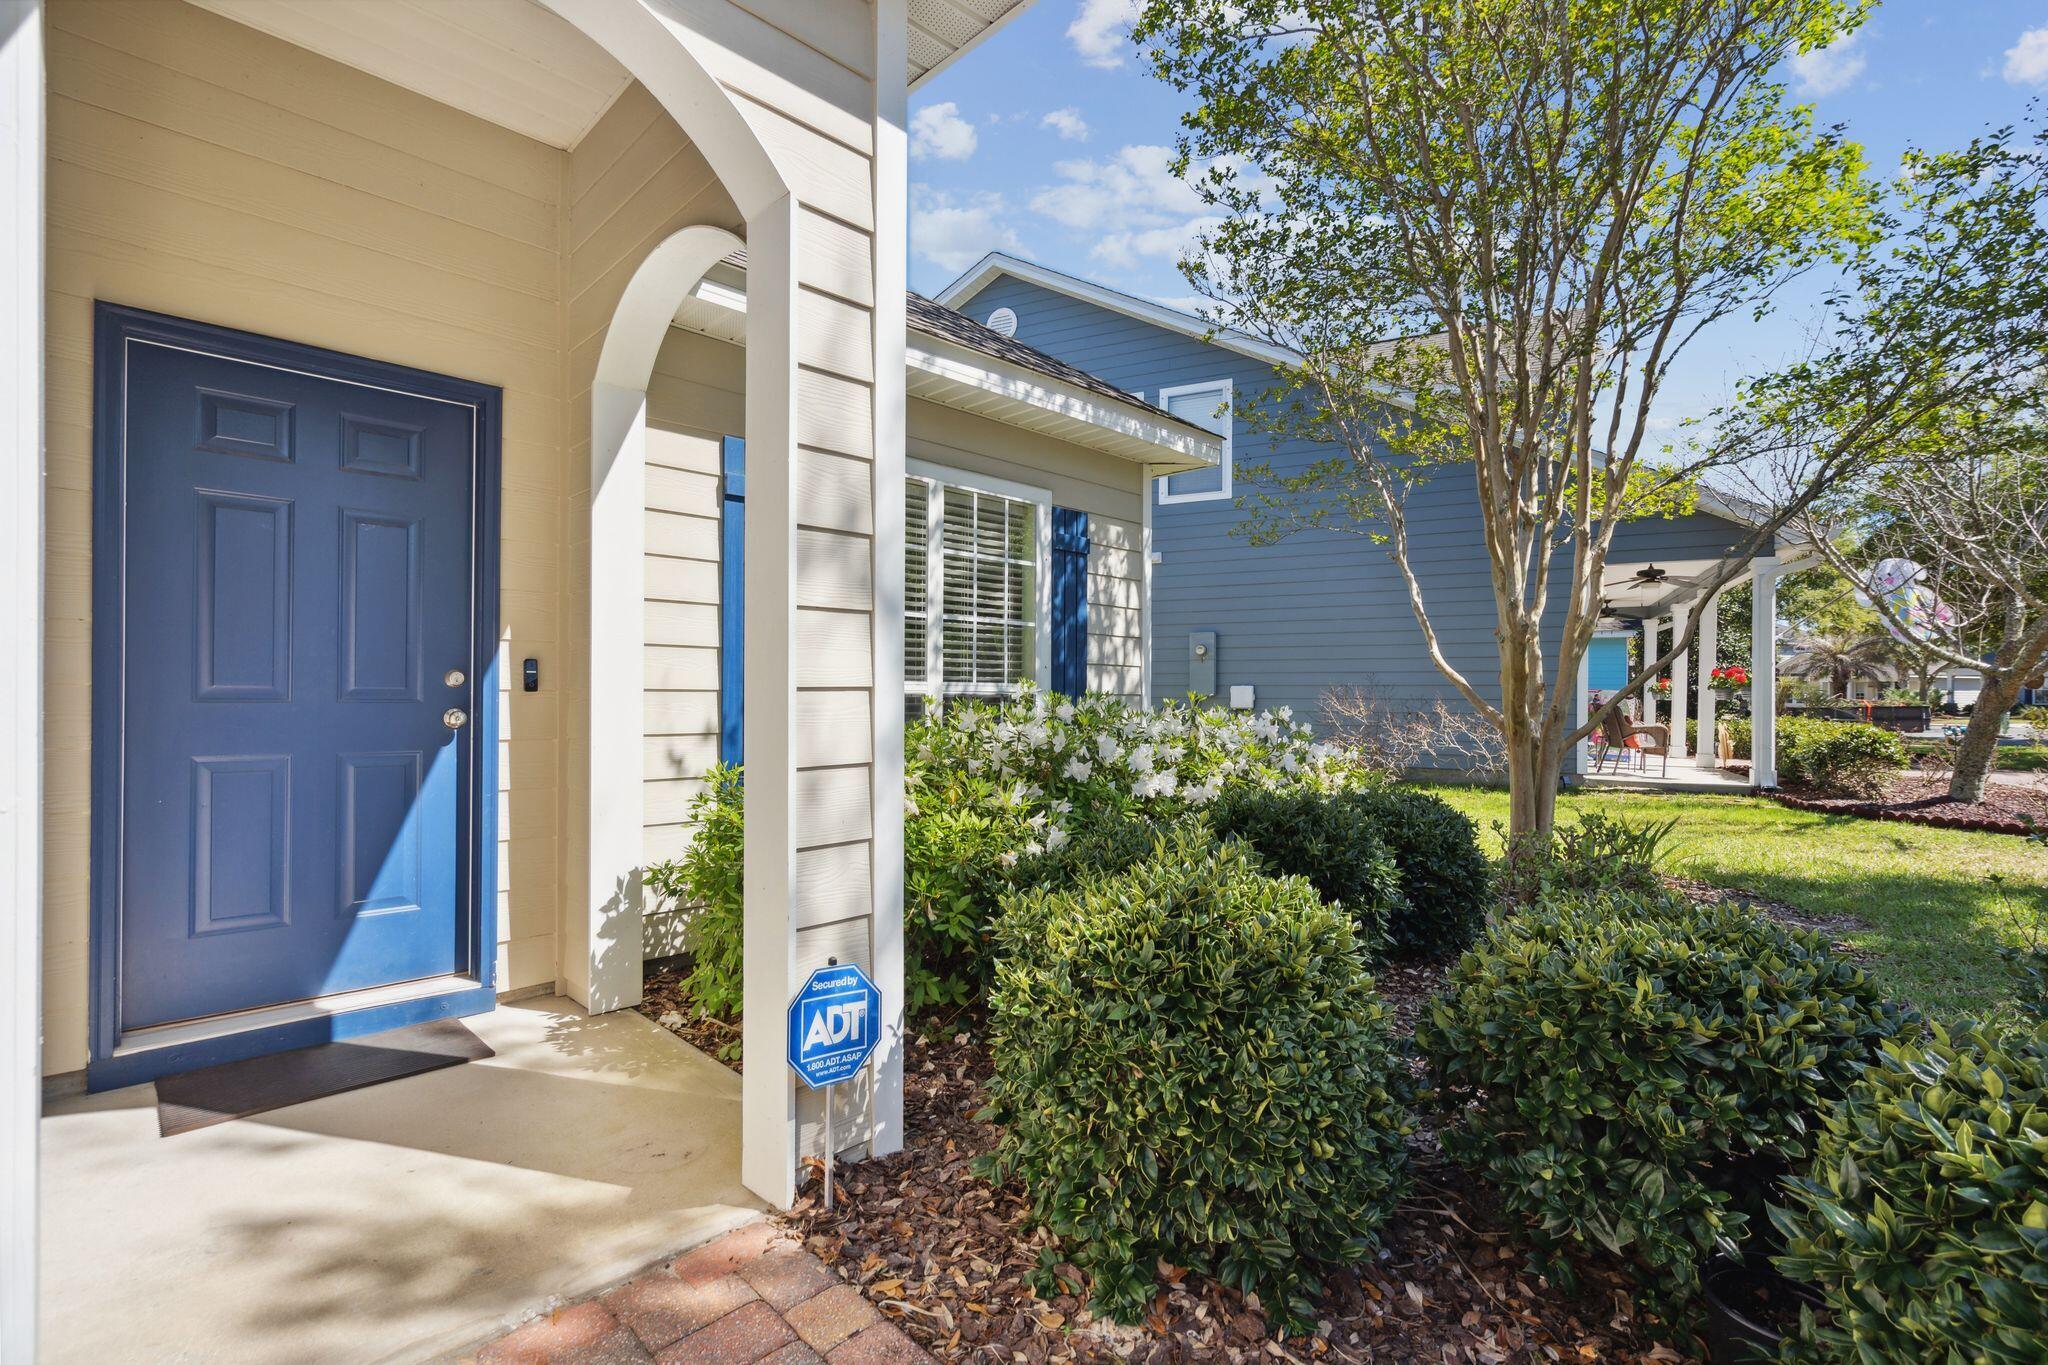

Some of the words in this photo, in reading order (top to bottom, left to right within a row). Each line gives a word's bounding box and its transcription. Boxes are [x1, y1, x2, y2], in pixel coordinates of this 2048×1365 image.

[812, 977, 846, 991] Secured
[847, 976, 858, 986] by
[803, 1000, 866, 1052] ADT
[816, 1065, 851, 1077] www.ADT.com
